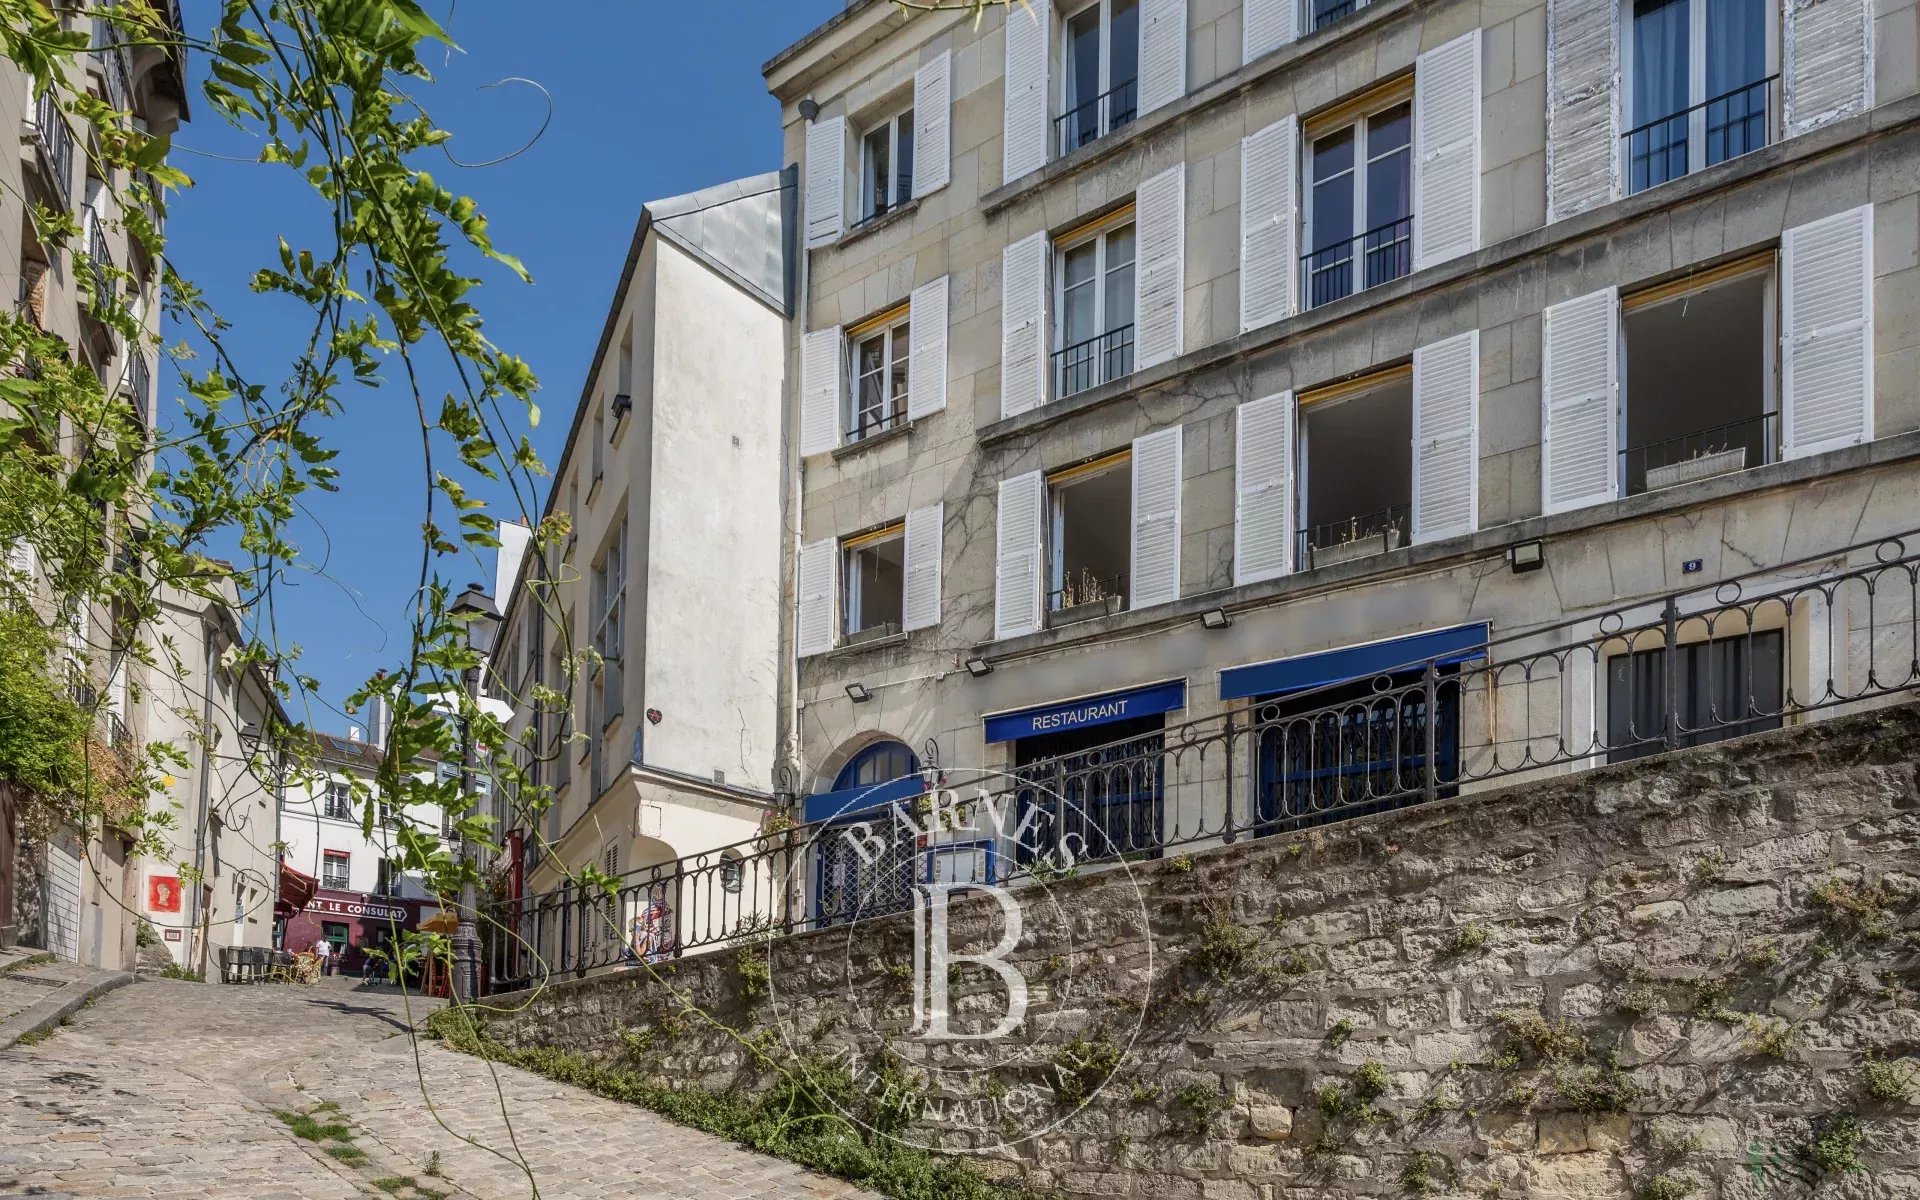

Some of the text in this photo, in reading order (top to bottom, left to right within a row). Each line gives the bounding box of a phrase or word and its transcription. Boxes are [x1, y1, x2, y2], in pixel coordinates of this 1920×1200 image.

[1688, 562, 1697, 571] 9
[1032, 699, 1128, 731] RESTAURANT
[329, 902, 341, 912] LE
[347, 904, 403, 919] CONSULAT
